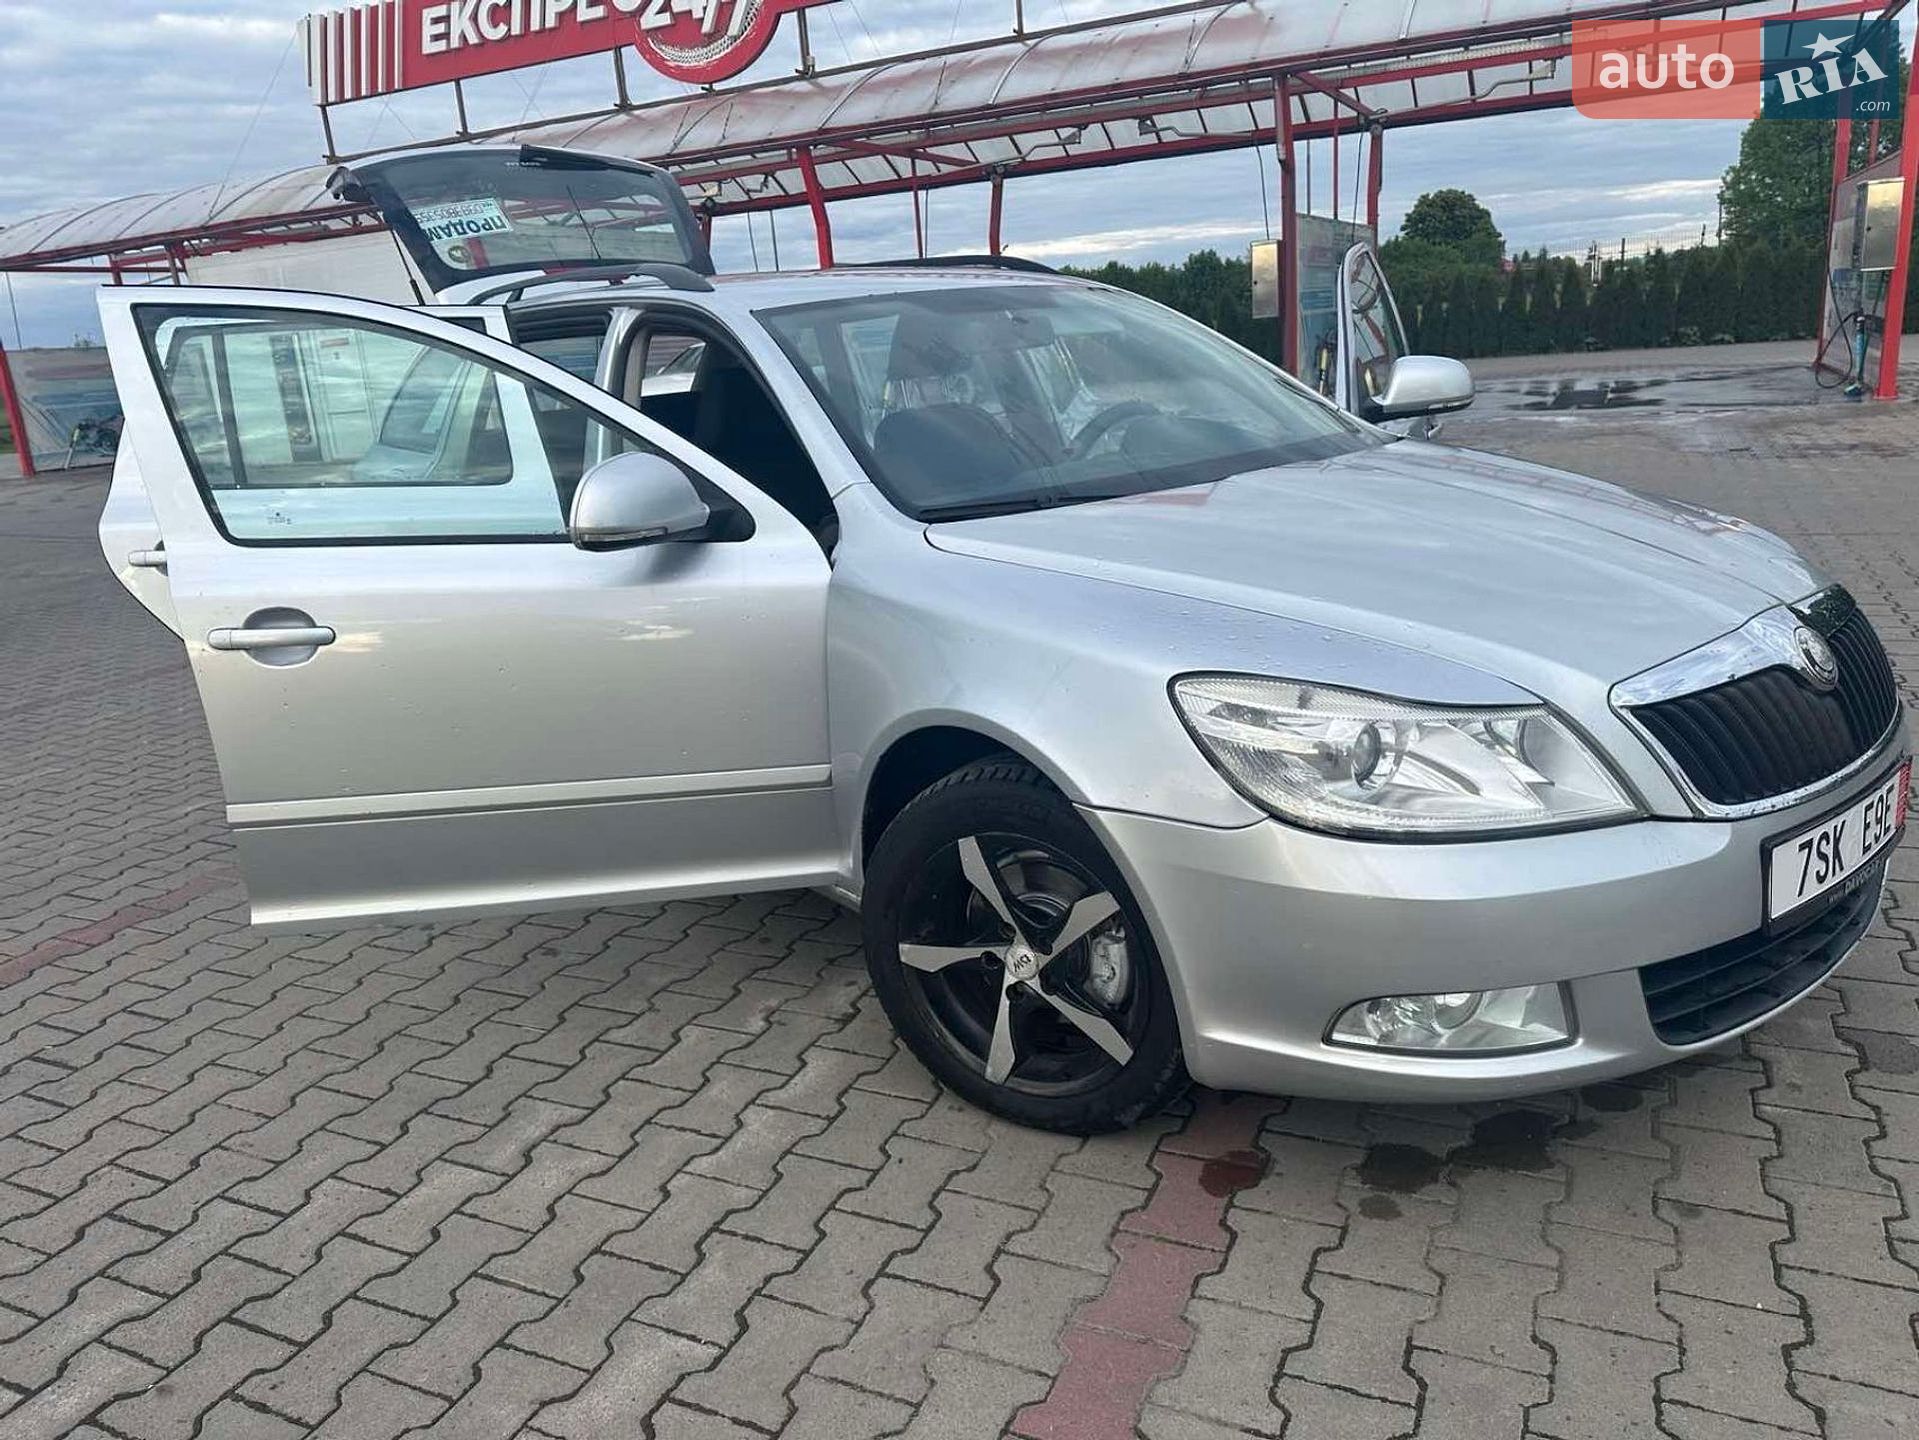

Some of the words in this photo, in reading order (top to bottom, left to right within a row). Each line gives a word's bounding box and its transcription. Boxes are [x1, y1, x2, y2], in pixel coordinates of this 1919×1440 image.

[421, 0, 642, 55] ЕКСПР
[422, 214, 508, 242] ПРОДАМ
[1797, 819, 1846, 898] 7SK
[1862, 786, 1893, 855] E9E
